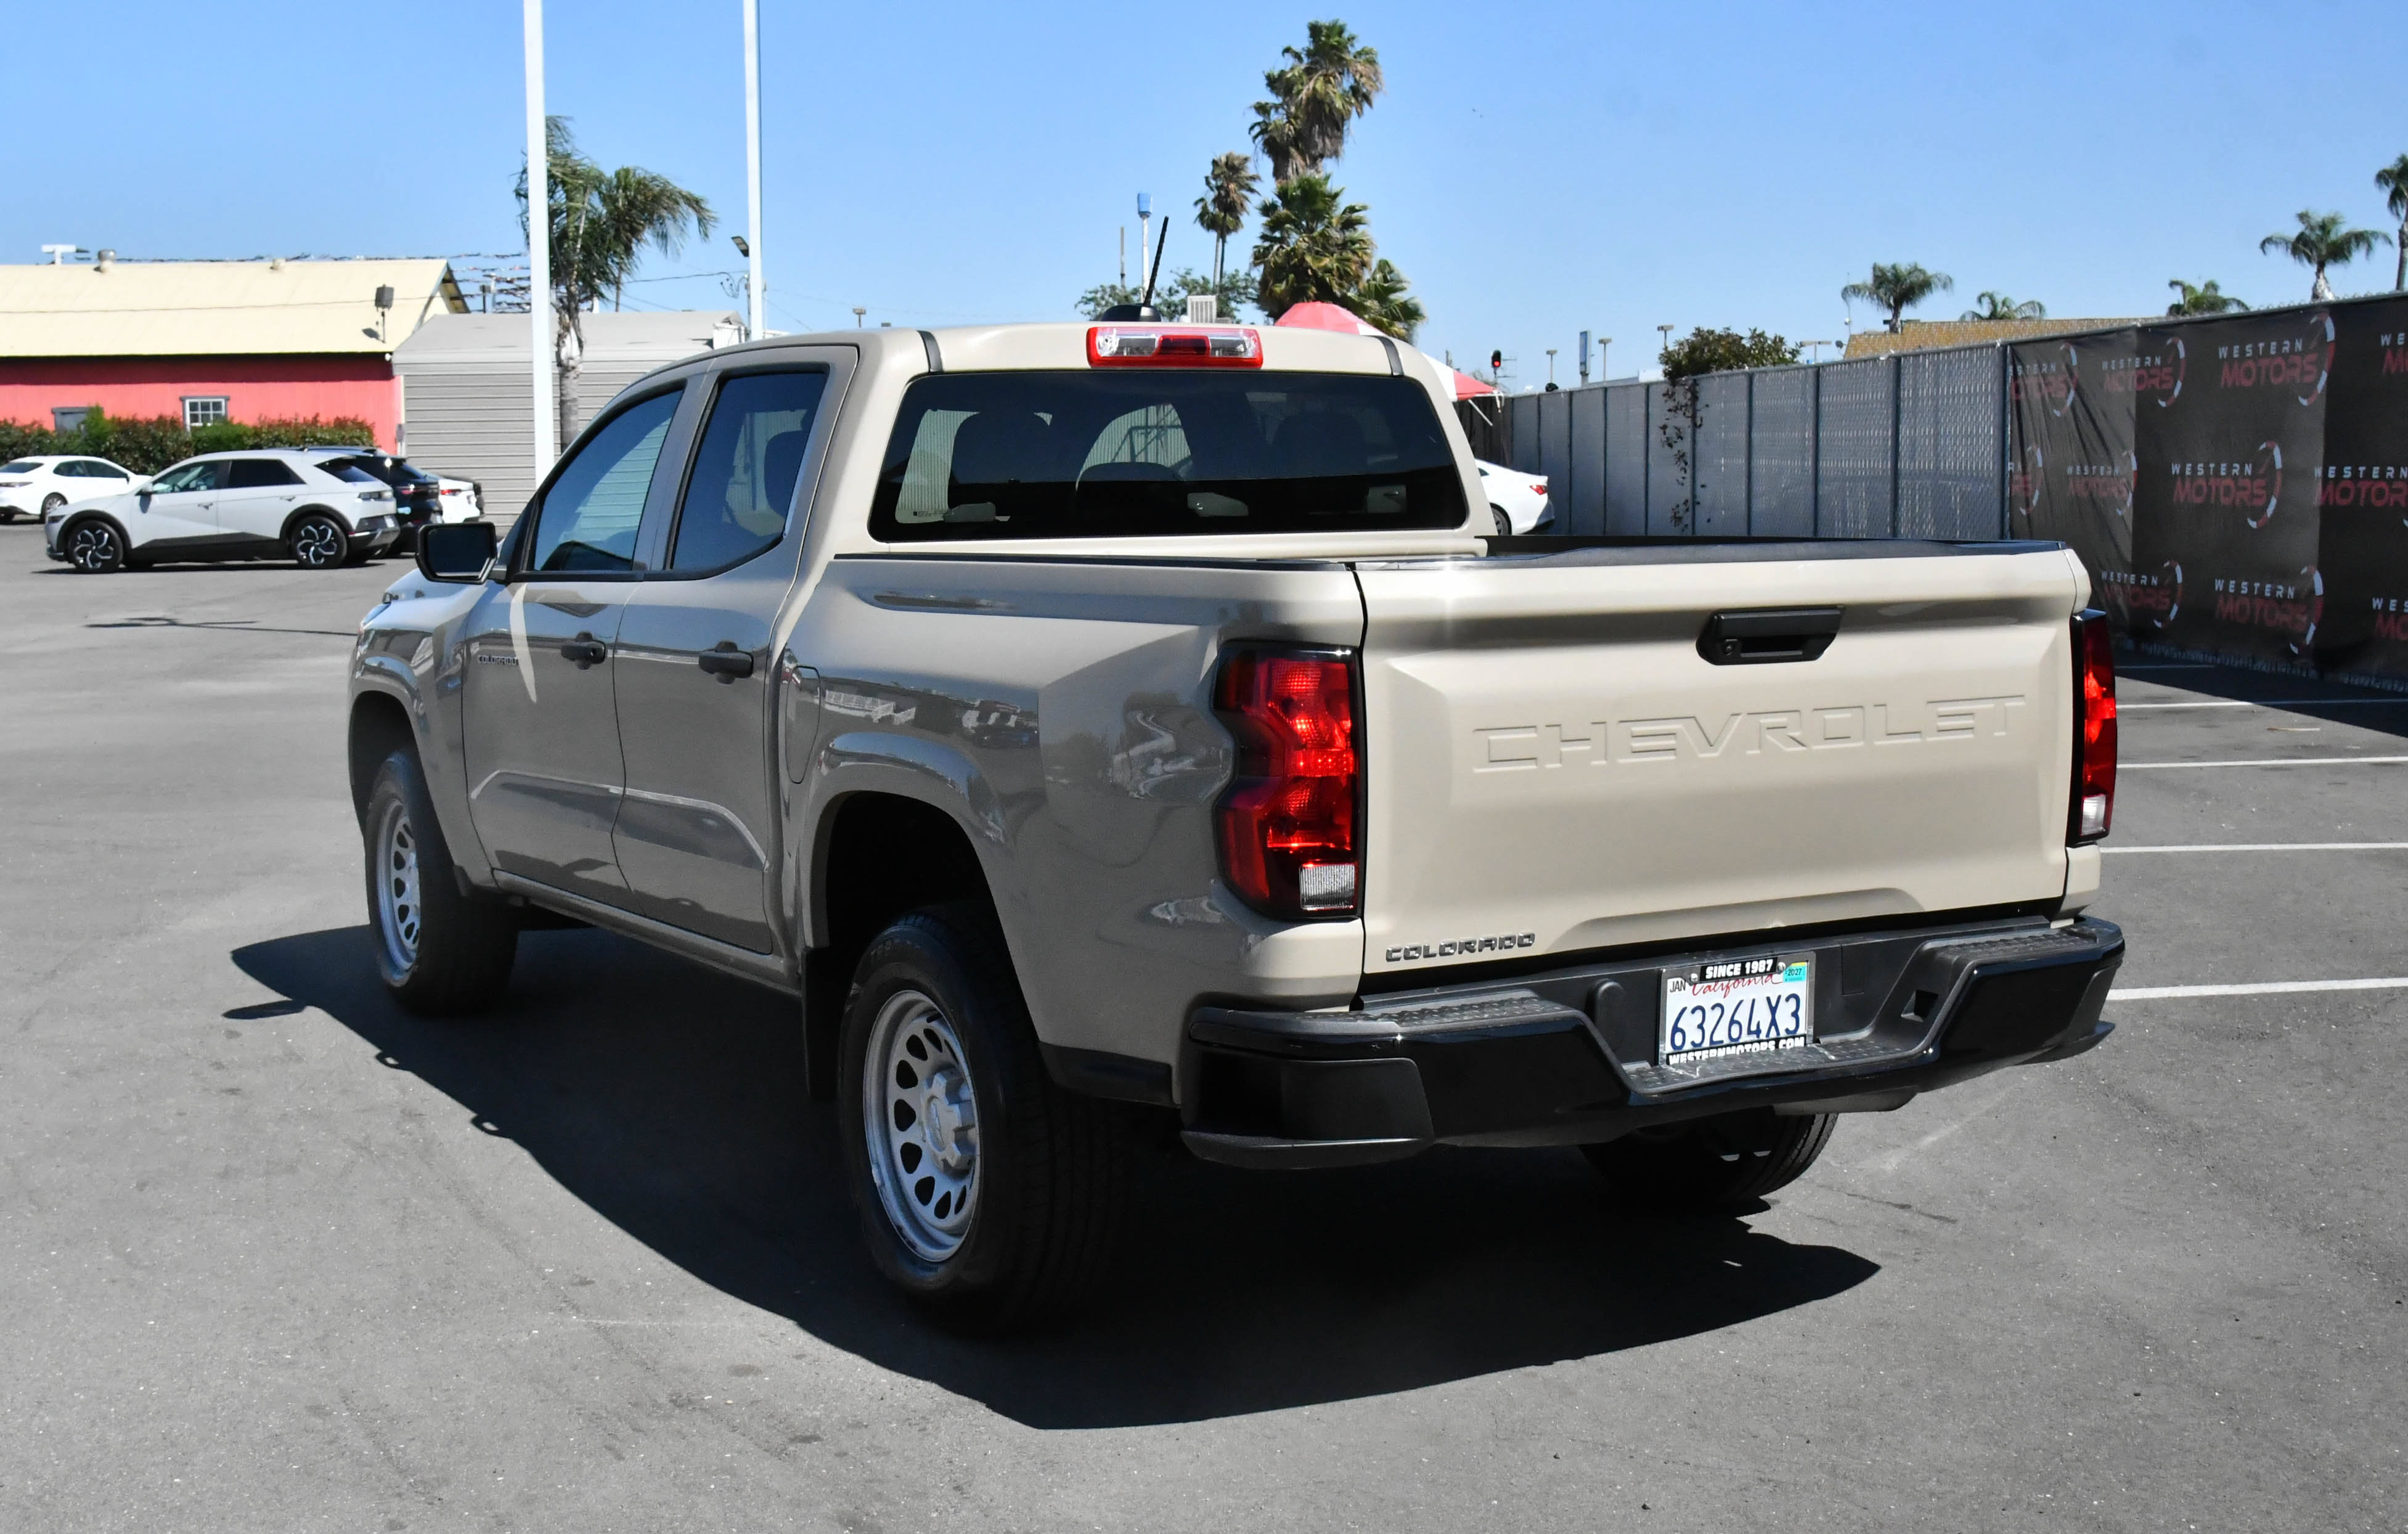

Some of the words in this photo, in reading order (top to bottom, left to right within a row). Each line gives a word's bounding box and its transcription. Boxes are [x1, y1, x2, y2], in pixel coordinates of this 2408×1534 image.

[2218, 338, 2303, 359] WESTERN
[2102, 356, 2161, 370] WESTERN
[2220, 353, 2318, 390] MOTORS
[2104, 366, 2174, 392] MOTORS
[2171, 463, 2252, 476] WESTERN
[2314, 466, 2408, 479] WESTERN
[2173, 476, 2267, 507] MOTORS
[2313, 479, 2408, 507] MOTOR
[2102, 571, 2158, 586] WESTERN
[2214, 579, 2295, 599] WESTERN
[2218, 594, 2308, 633] MOTORS
[1472, 694, 2026, 773] CHEVROLET
[1386, 931, 1536, 963] COLORADO
[1705, 963, 1742, 979] SINCE
[1745, 958, 1774, 974] 1987
[1787, 968, 1802, 976] 2027
[1670, 980, 1686, 993] JAN
[1692, 974, 1783, 998] California
[1670, 993, 1801, 1051] 63264X3
